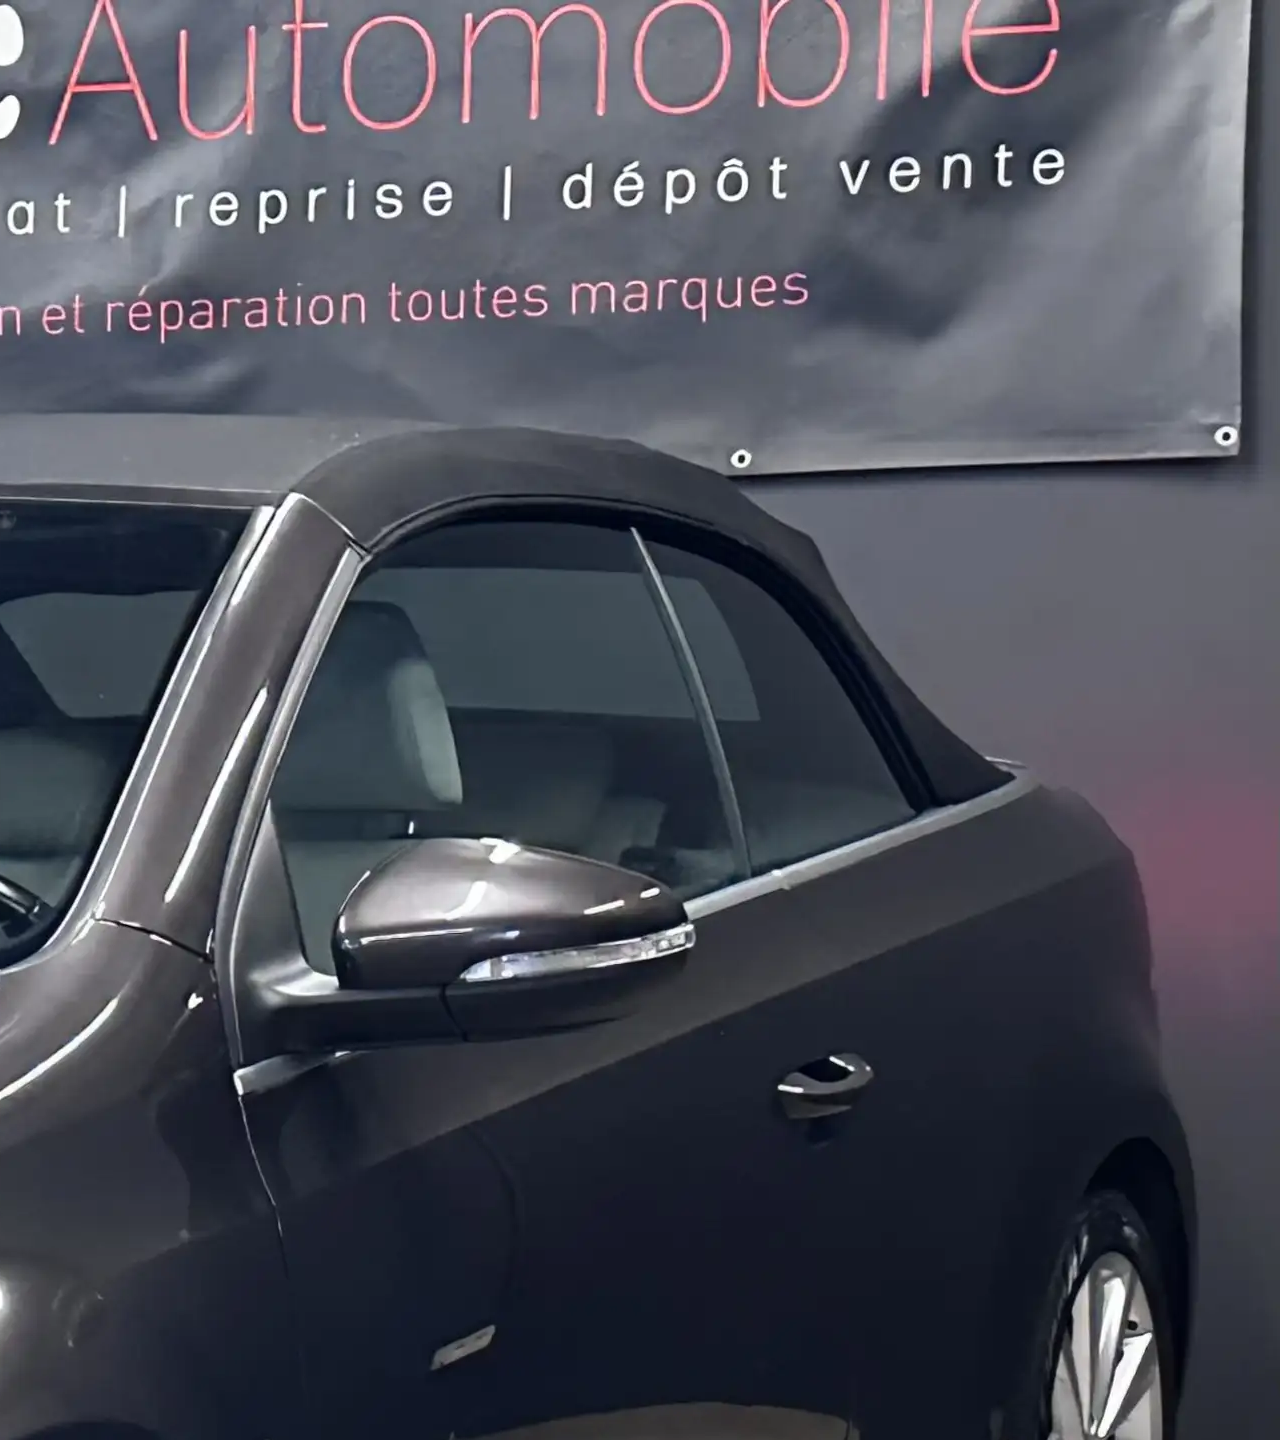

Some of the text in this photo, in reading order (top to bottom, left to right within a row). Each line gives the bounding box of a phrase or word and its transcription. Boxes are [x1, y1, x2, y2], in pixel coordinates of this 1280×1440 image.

[48, 0, 1062, 145] Automobile
[174, 178, 454, 235] reprise
[562, 156, 789, 216] dépôt
[839, 144, 1066, 196] vente
[42, 294, 86, 336] et
[106, 284, 367, 344] réparation
[389, 281, 548, 320] toutes
[570, 269, 810, 323] marques
